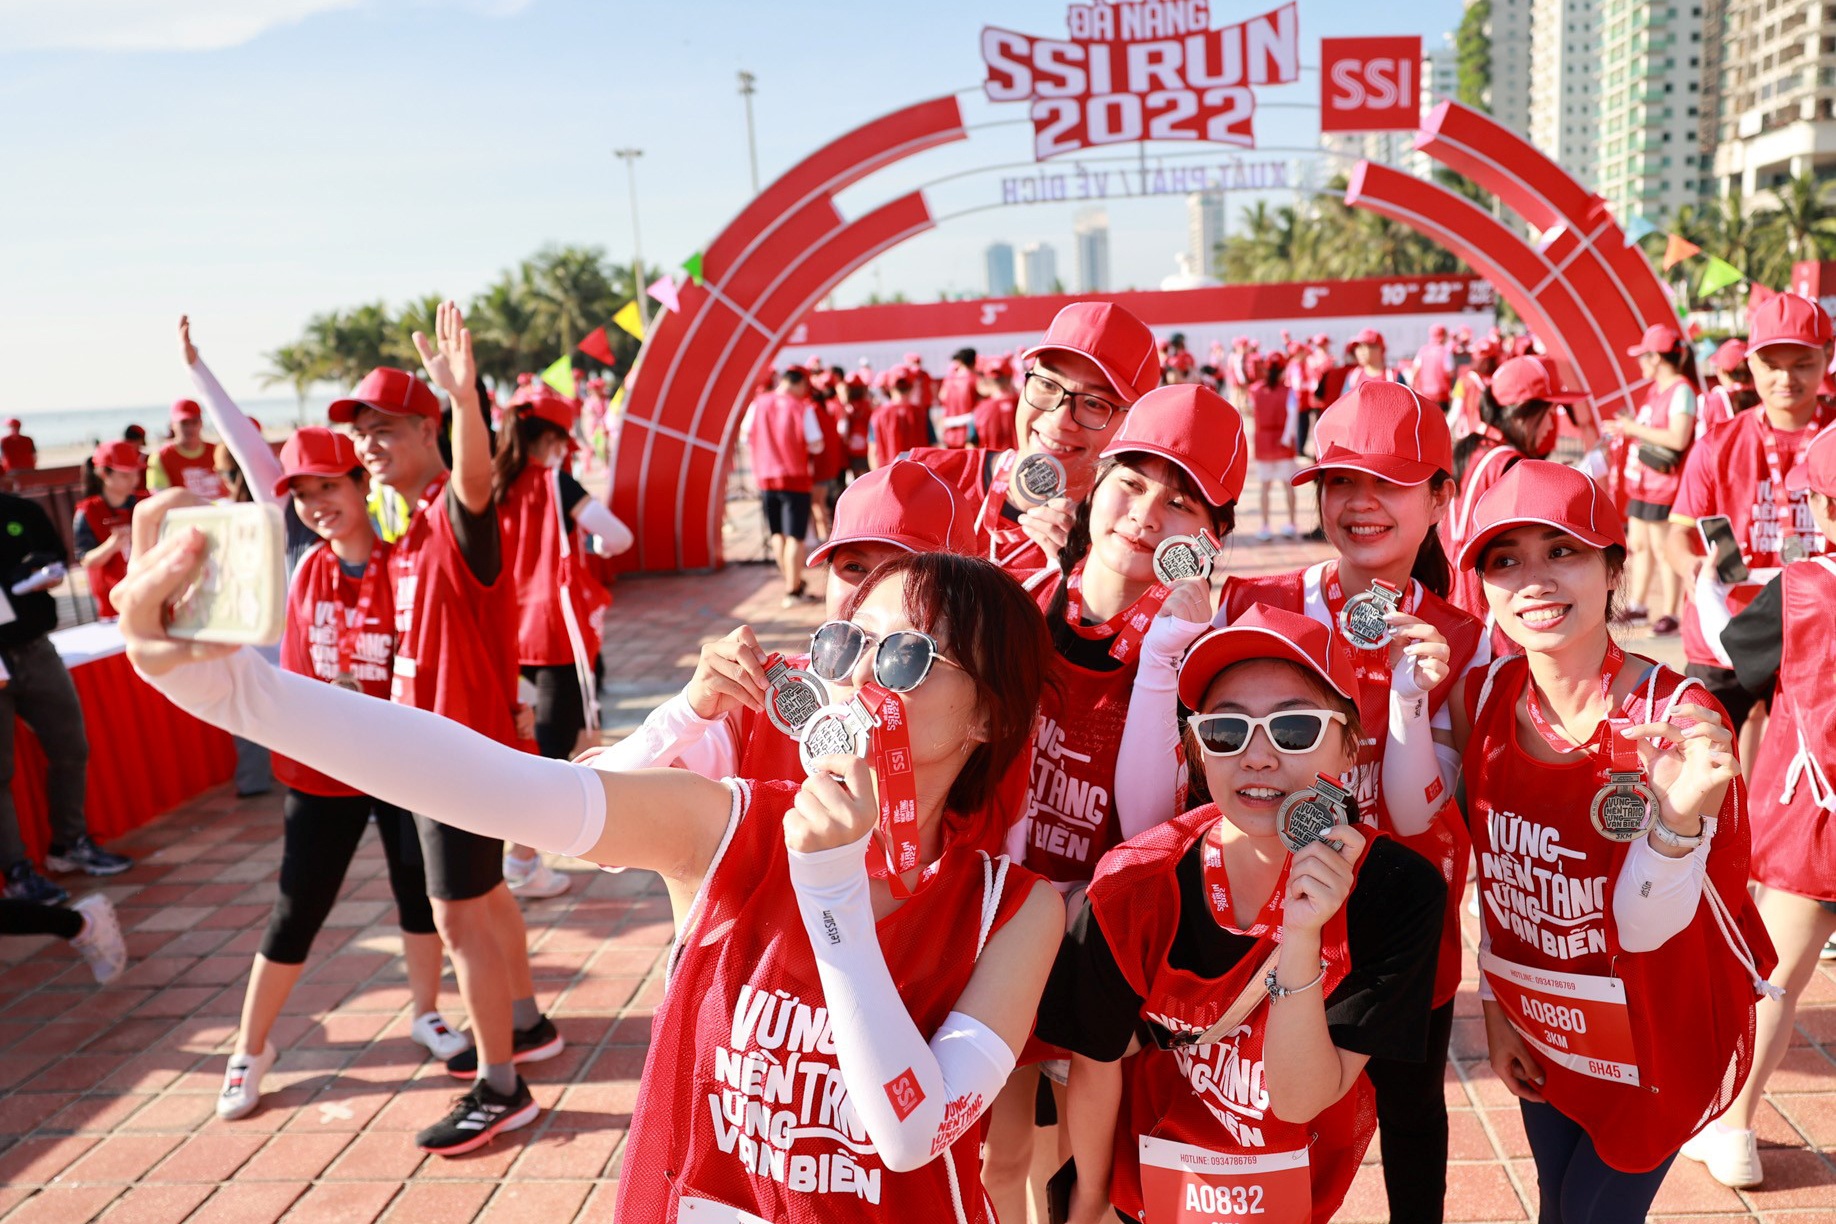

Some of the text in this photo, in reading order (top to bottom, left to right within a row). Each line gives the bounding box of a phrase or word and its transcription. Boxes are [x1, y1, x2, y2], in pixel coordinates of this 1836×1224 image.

[982, 5, 1298, 99] SSI RUN
[1331, 58, 1411, 109] SSI
[1033, 87, 1254, 158] 2022
[892, 751, 906, 772] SSI
[1488, 808, 1587, 863] VỮNG
[1481, 852, 1535, 892] NỀN
[1484, 890, 1607, 960] VẠN BIẾN
[1520, 994, 1587, 1035] A0880
[1544, 1029, 1569, 1049] 3KM
[714, 1045, 802, 1104] NỀN
[1588, 1060, 1621, 1079] 6H45
[892, 1076, 918, 1113] SSI
[1180, 1154, 1257, 1166] HOTLINE: 0934786769
[1185, 1183, 1265, 1215] A0832
